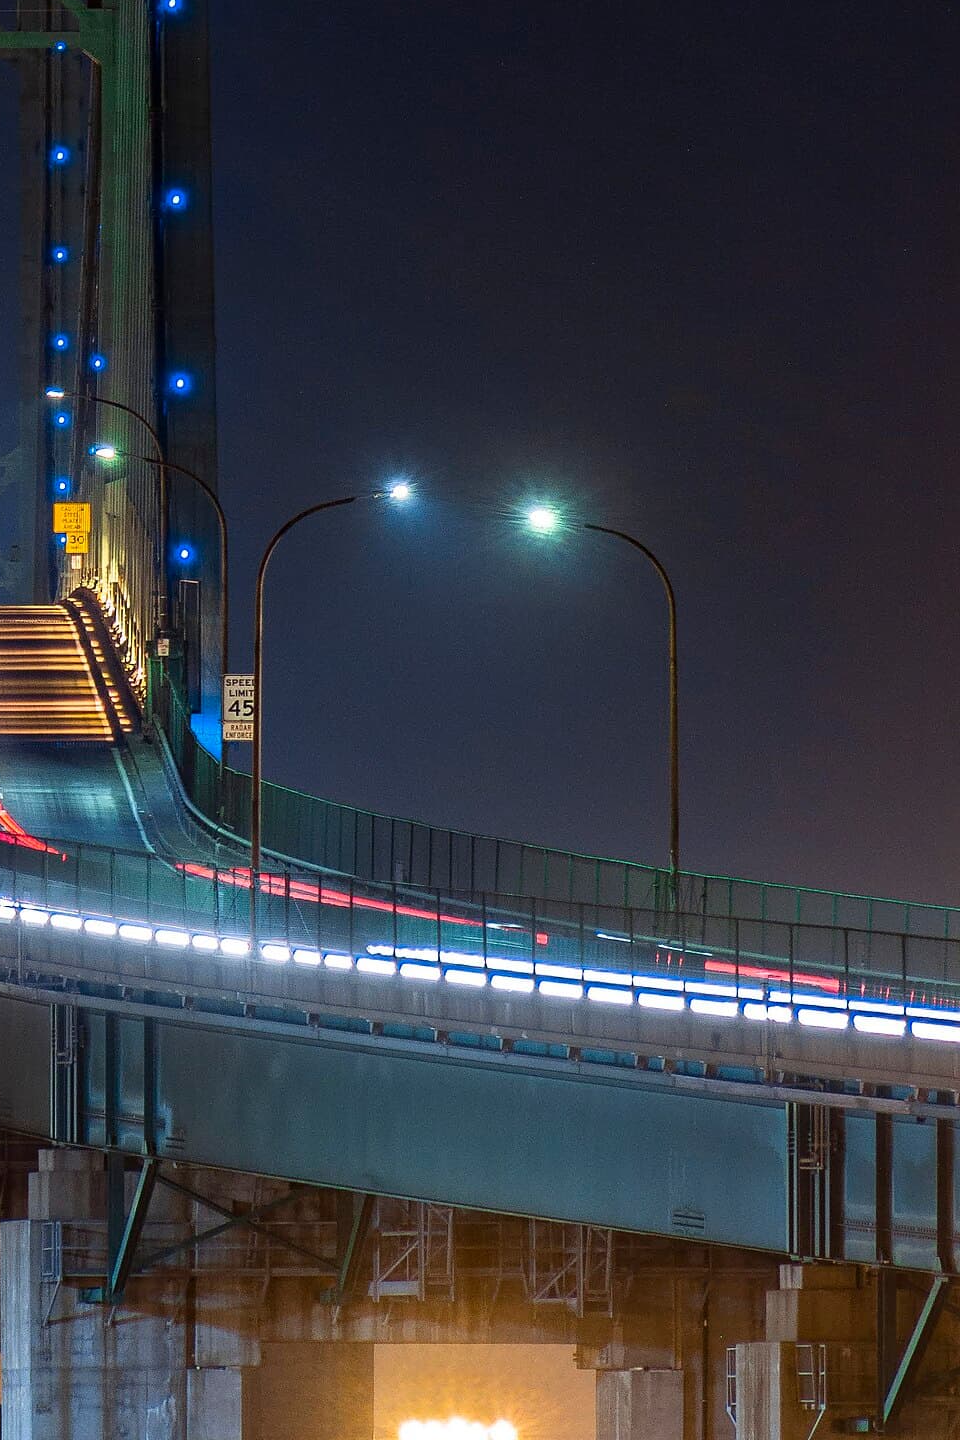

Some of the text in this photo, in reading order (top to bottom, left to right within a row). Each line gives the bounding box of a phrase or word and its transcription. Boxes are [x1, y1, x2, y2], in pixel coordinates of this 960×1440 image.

[69, 535, 84, 544] 30
[229, 689, 255, 697] LIMIT
[228, 700, 254, 716] 45
